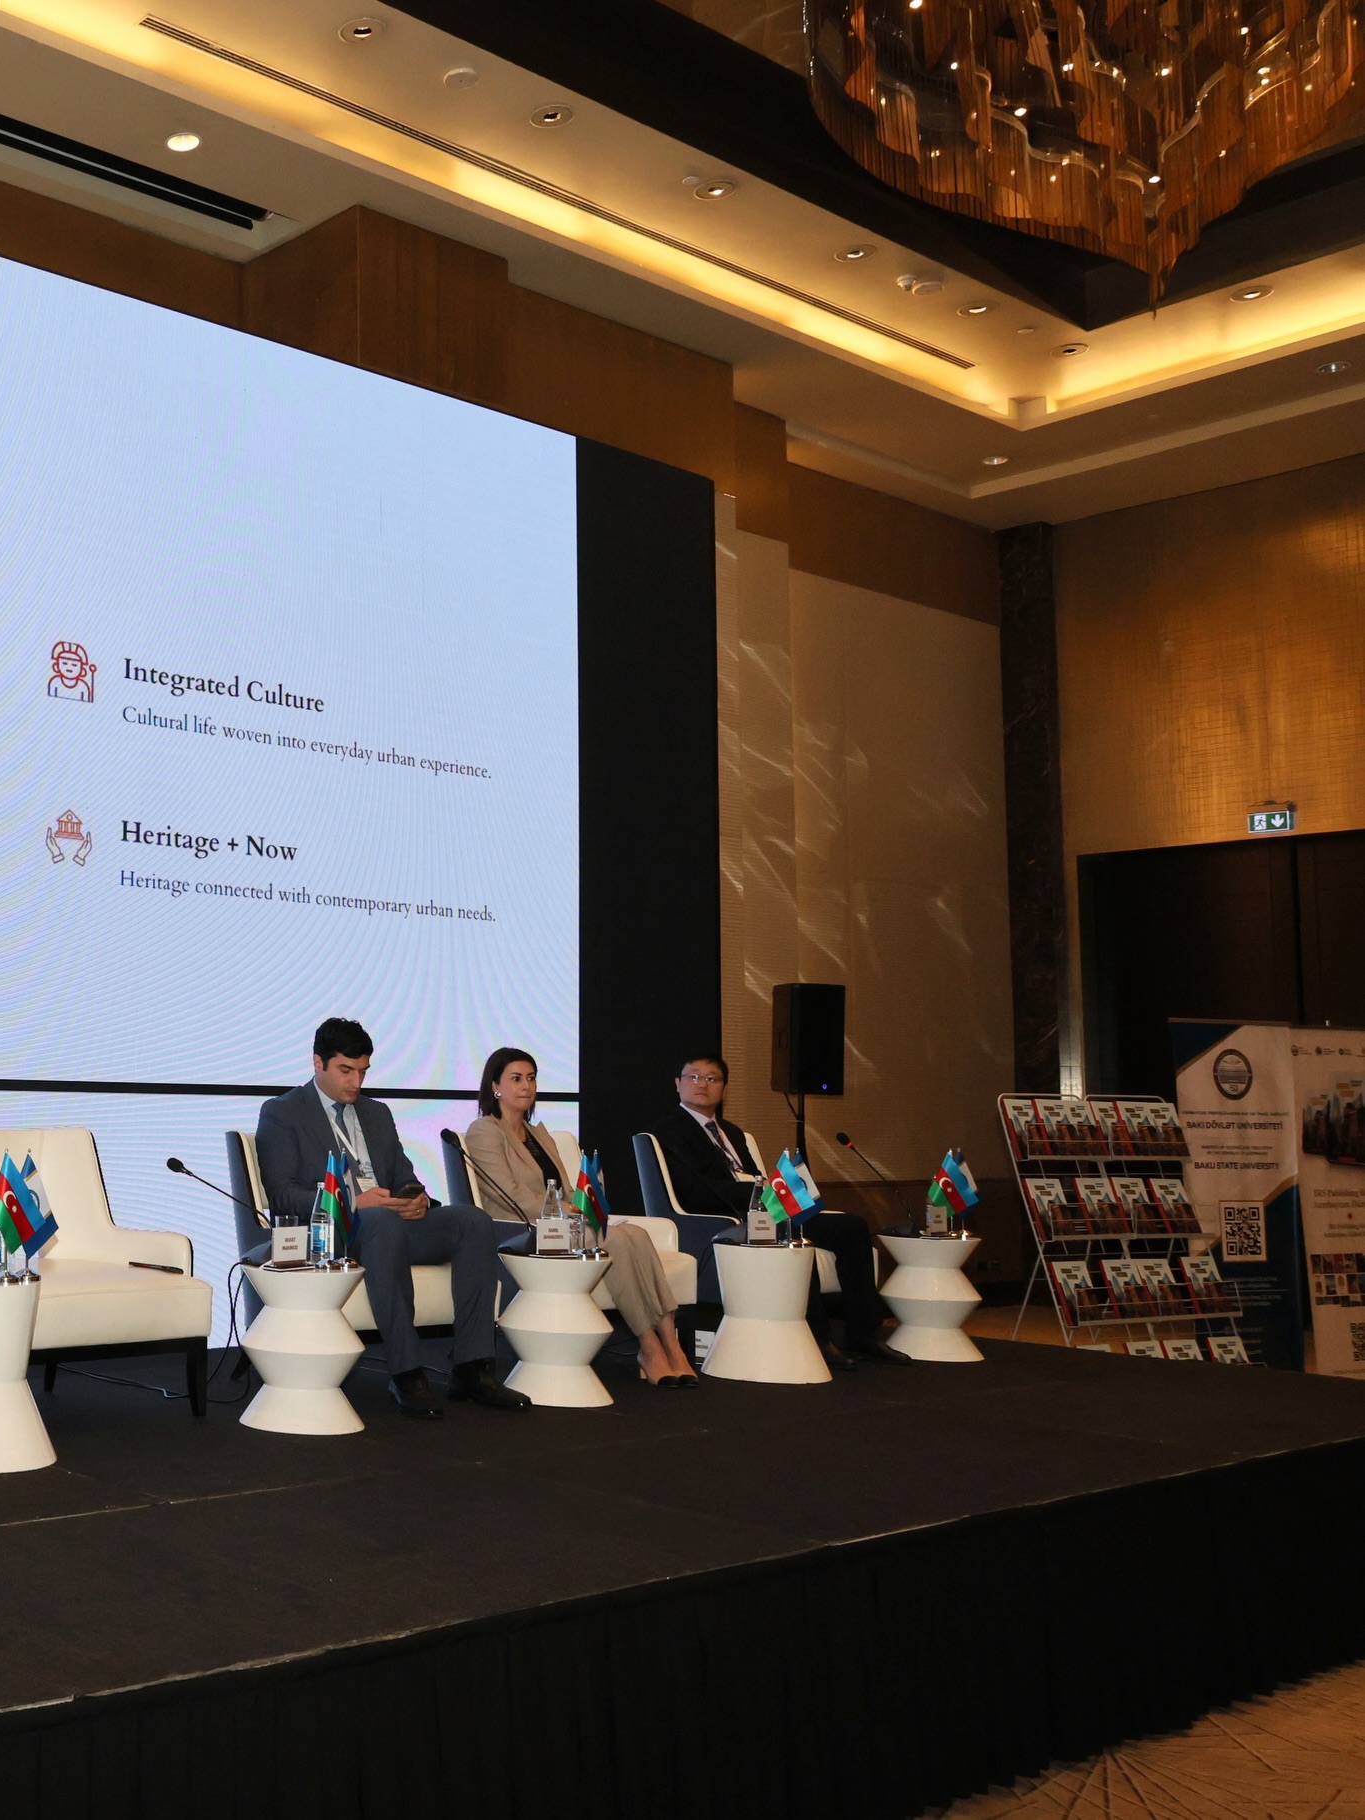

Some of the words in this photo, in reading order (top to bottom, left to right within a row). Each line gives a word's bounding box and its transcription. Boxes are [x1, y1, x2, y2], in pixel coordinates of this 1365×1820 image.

[124, 657, 240, 698] Integrated
[246, 680, 325, 713] Culture
[121, 706, 189, 732] Cultural
[193, 714, 217, 737] life
[221, 726, 273, 745] woven
[276, 735, 307, 750] into
[309, 740, 373, 766] everyday
[377, 747, 416, 768] urban
[419, 758, 492, 779] experience.
[121, 819, 220, 860] Heritage
[227, 837, 239, 852] +
[246, 835, 297, 861] Now
[119, 869, 190, 898] Heritage
[194, 882, 274, 901] connected
[278, 886, 311, 905] with
[314, 894, 412, 919] contemporary
[415, 898, 454, 919] urban
[457, 904, 496, 922] needs.
[1195, 1162, 1215, 1170] BAKU
[1217, 1162, 1238, 1170] STATE
